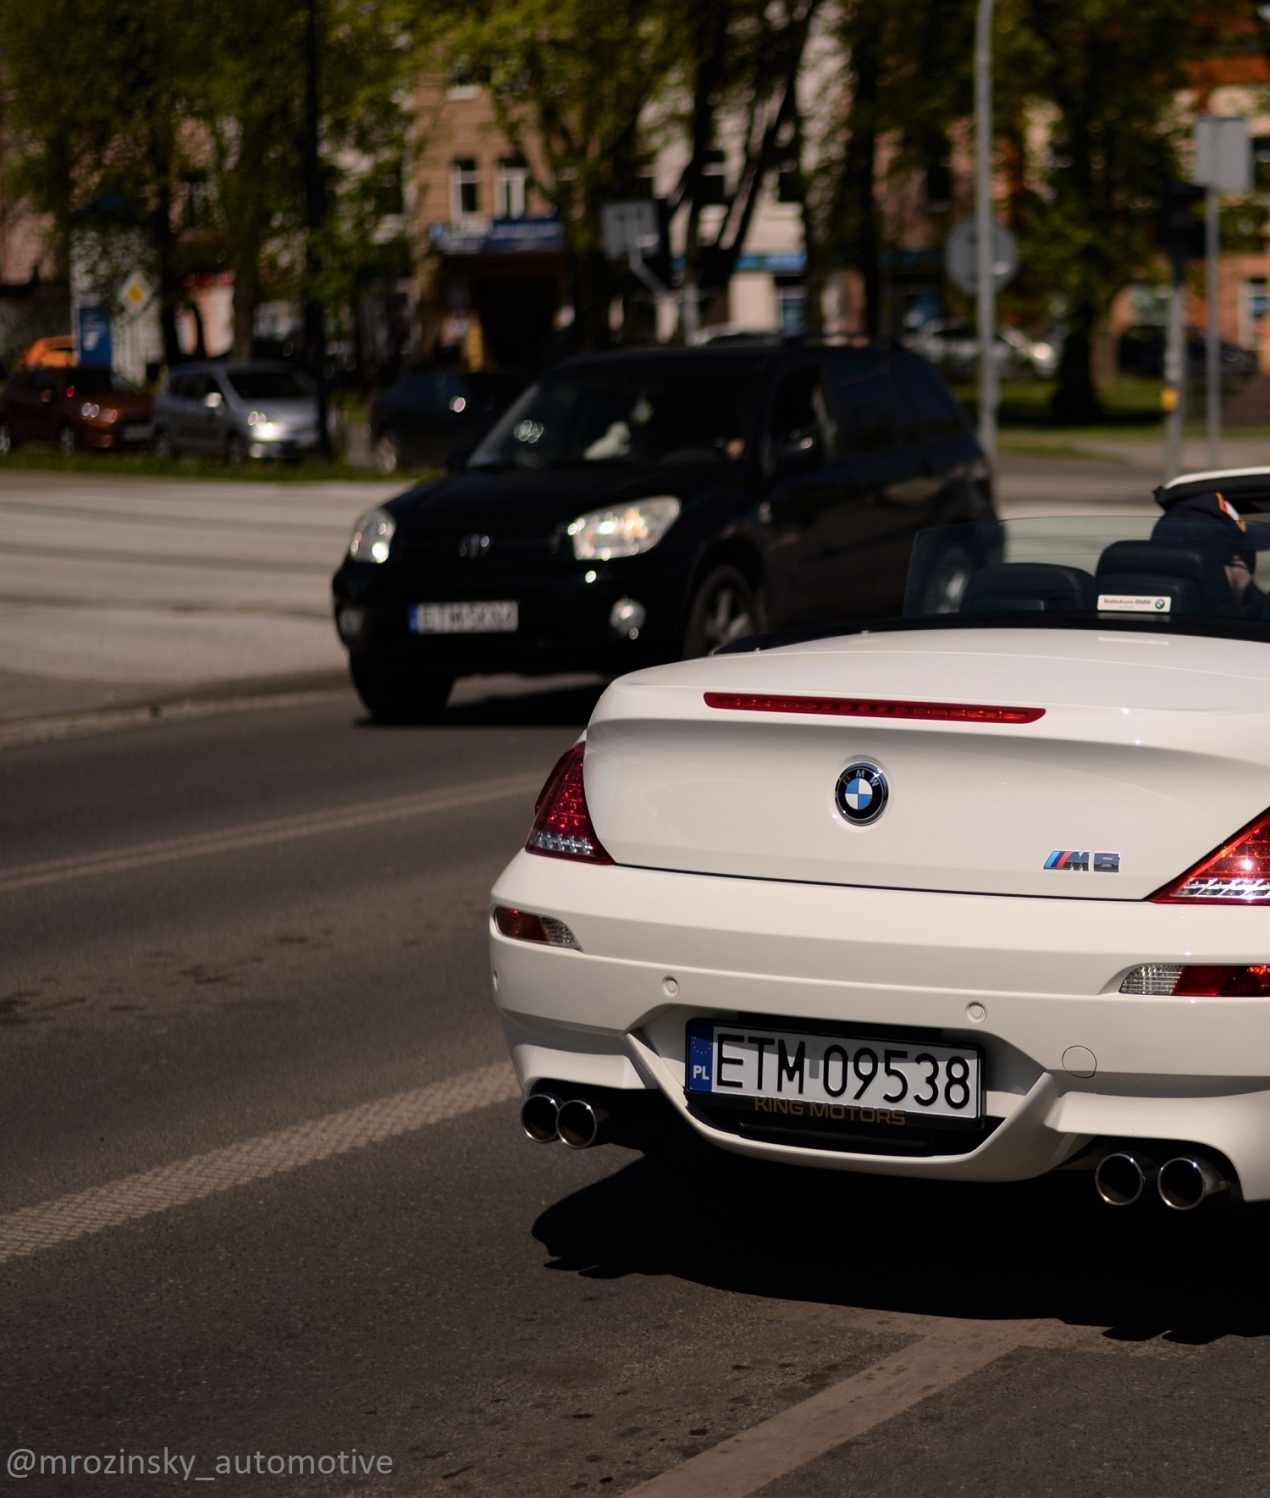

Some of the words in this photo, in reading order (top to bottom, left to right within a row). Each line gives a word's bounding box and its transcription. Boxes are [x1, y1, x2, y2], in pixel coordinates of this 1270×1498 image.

[692, 1064, 710, 1081] PL
[716, 1033, 806, 1095] ETM
[822, 1044, 971, 1110] 09538
[754, 1096, 804, 1116] KING
[809, 1101, 906, 1126] MOTORS
